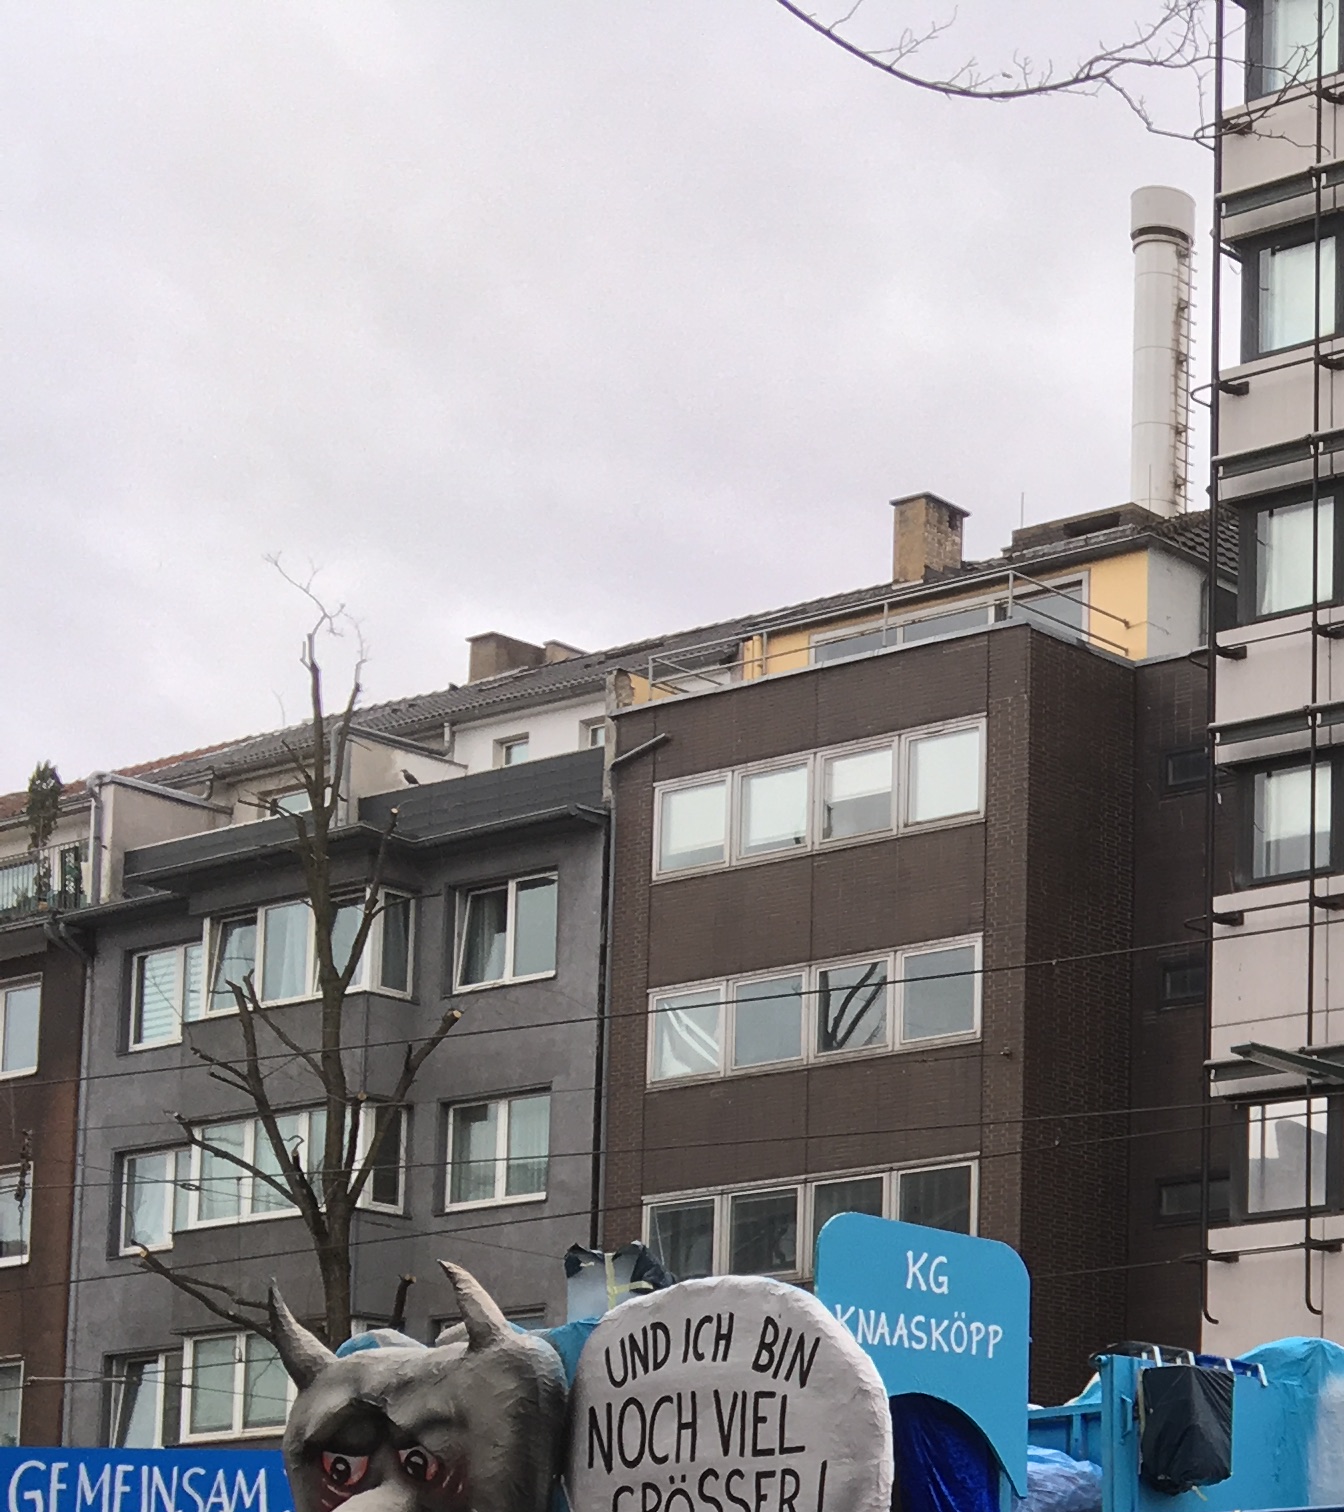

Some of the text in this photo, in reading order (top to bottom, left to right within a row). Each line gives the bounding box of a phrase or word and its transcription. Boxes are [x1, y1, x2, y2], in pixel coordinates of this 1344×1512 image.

[906, 1250, 949, 1295] KG
[604, 1312, 821, 1388] UND ICH BIN
[835, 1303, 1003, 1359] KNAASKÖPP
[587, 1389, 805, 1475] NOCH VIEL
